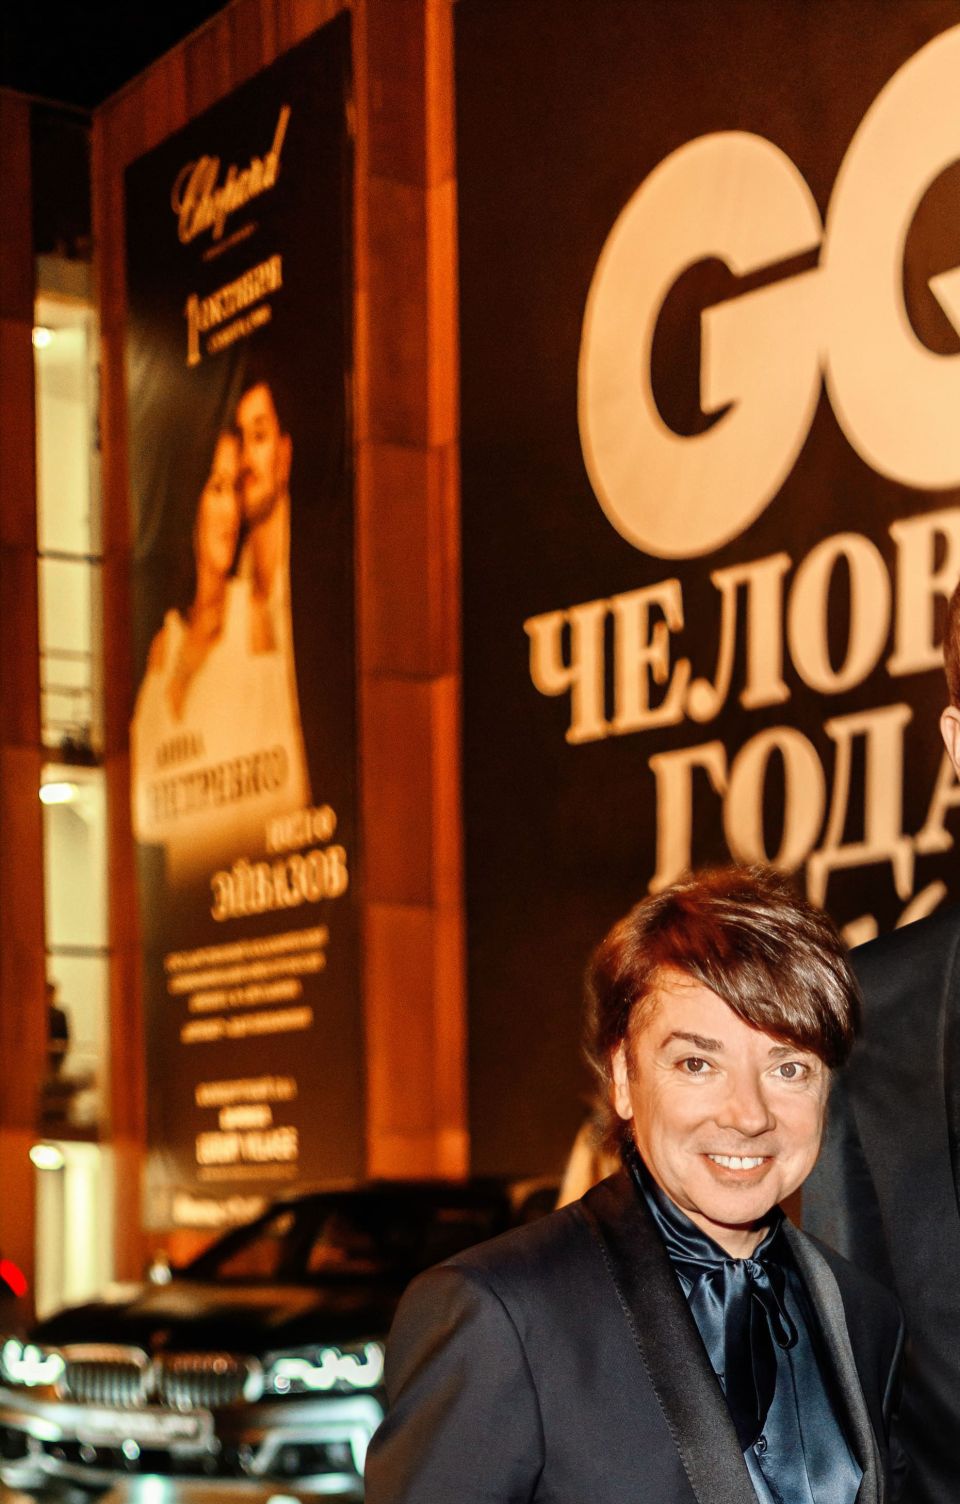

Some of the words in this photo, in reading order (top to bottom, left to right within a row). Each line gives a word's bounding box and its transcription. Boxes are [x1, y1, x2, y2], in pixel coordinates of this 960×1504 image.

[171, 104, 291, 243] Chopard
[186, 294, 201, 367] 1
[211, 844, 348, 922] ЭЙВАЗОВ
